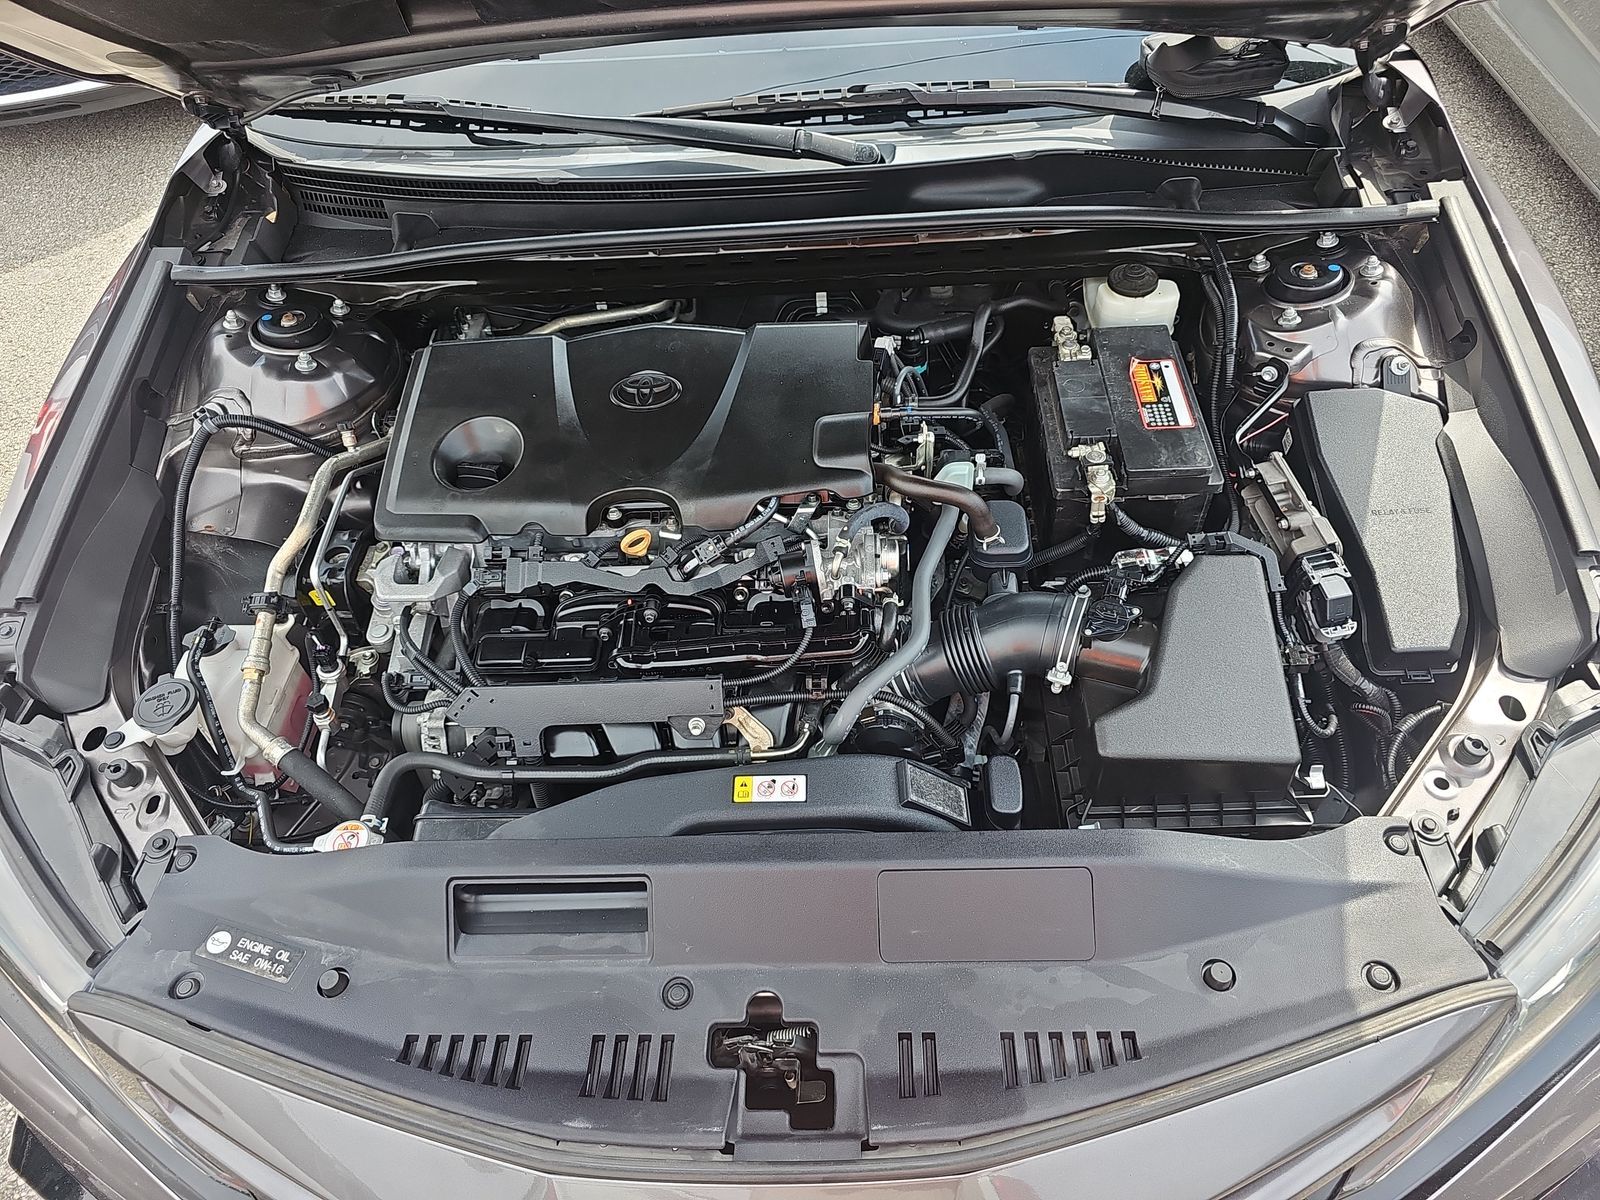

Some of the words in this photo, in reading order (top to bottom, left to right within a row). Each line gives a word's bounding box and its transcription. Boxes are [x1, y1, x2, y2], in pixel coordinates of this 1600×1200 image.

[1371, 508, 1400, 516] RELAY
[229, 949, 251, 964] SAE
[254, 957, 285, 975] 0W-16
[237, 937, 273, 956] ENGINE
[275, 949, 291, 963] OIL
